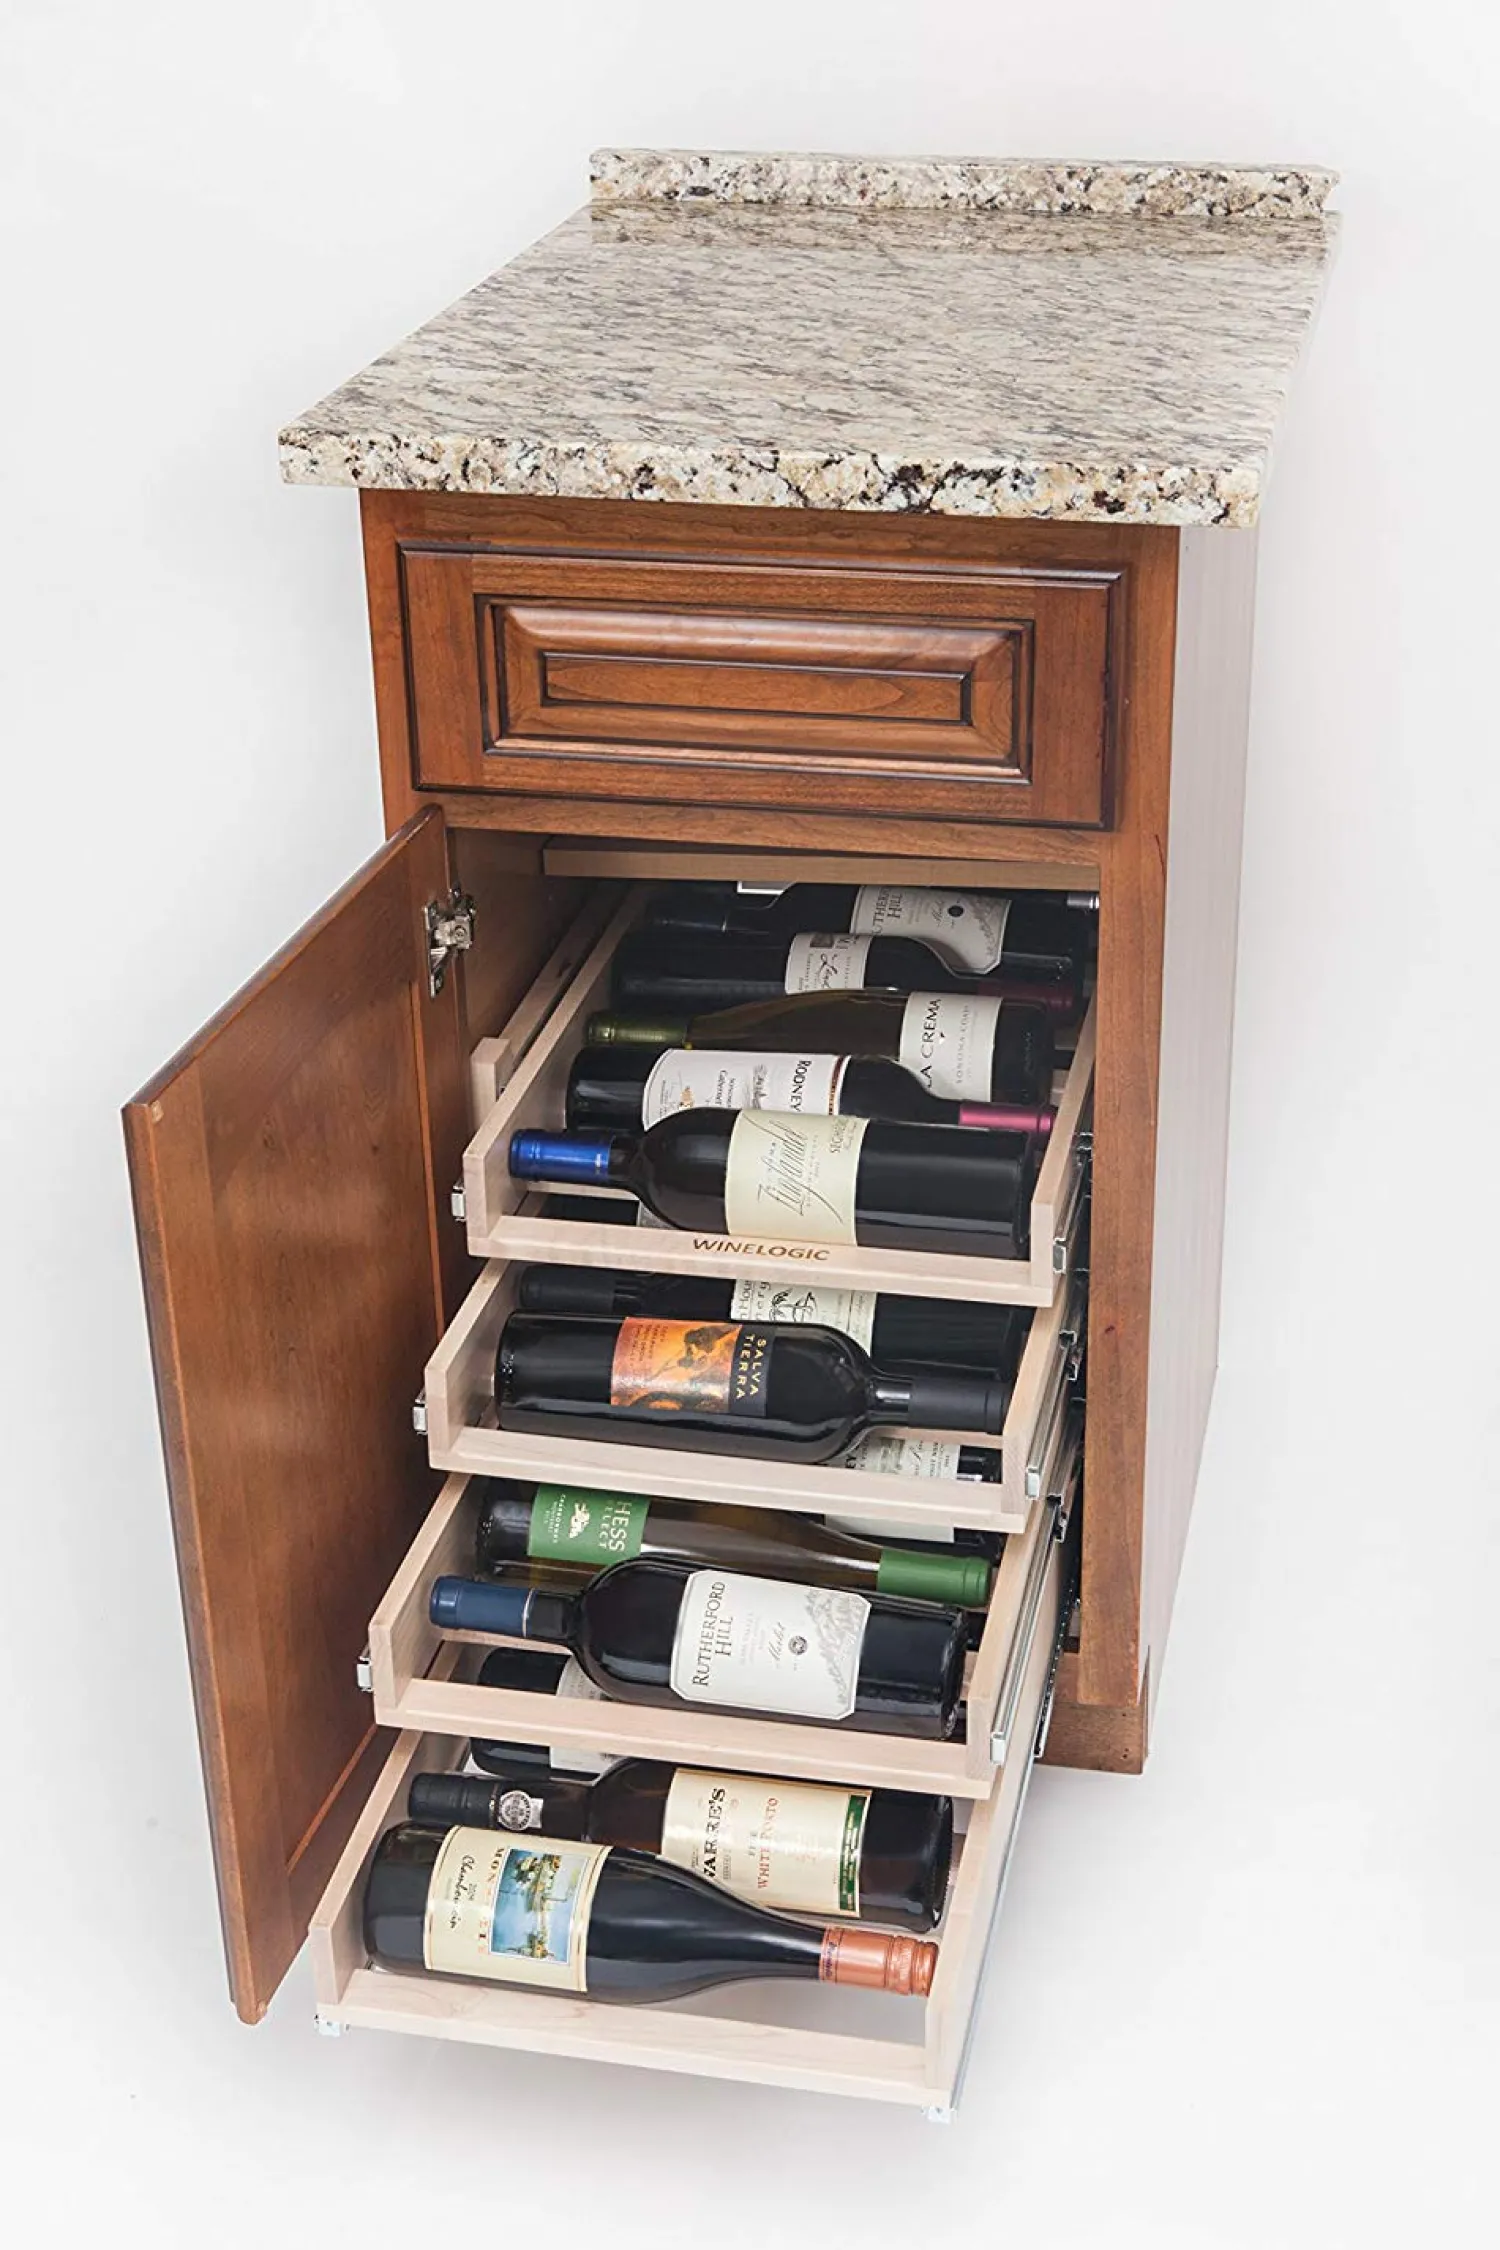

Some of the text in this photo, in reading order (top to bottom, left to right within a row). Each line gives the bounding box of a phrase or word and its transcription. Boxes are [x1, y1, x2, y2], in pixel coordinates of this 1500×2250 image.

[920, 999, 941, 1058] CREMA
[790, 1060, 812, 1112] RODNEY
[693, 1237, 831, 1262] WINELOGIC
[736, 1334, 755, 1399] TIERRA
[749, 1337, 767, 1396] SALVA
[608, 1501, 632, 1552] HESS
[692, 1581, 726, 1687] RUTHERFORD
[715, 1616, 734, 1657] HILL
[757, 1847, 769, 1889] WHITE
